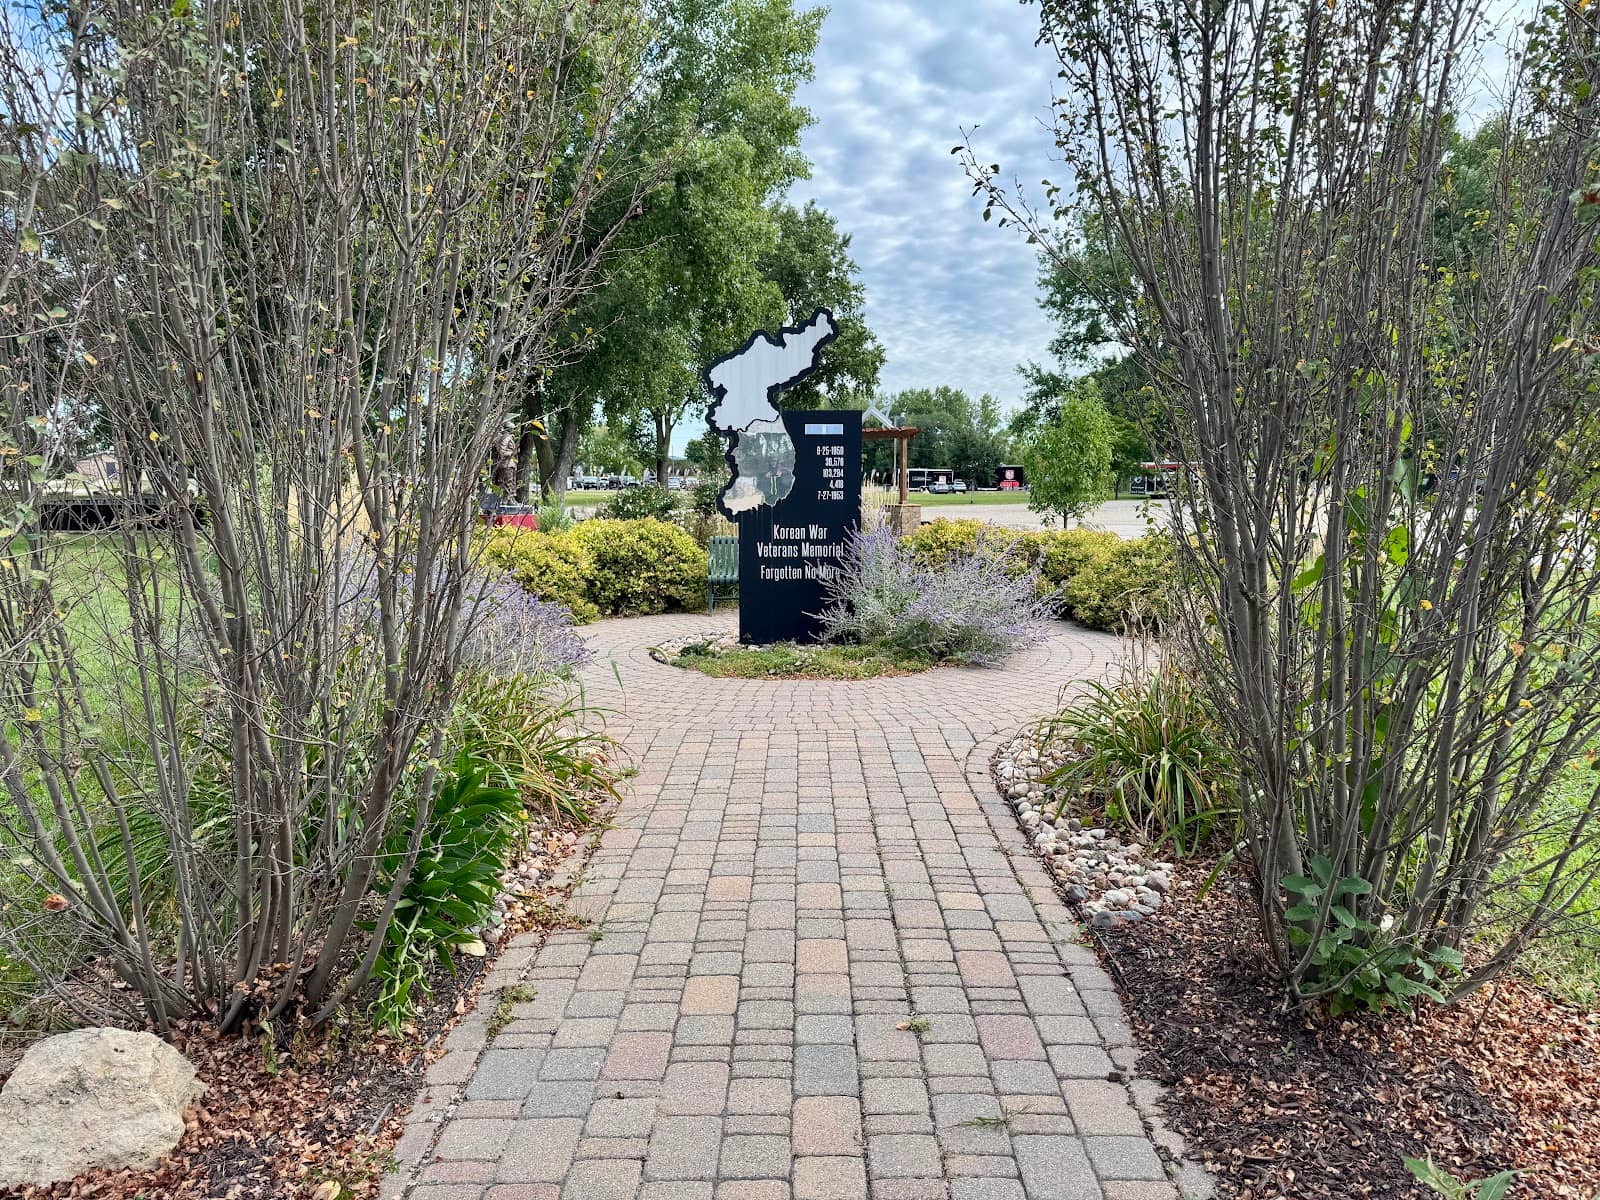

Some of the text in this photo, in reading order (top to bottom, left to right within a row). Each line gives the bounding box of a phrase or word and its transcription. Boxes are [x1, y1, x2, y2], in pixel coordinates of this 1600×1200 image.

[817, 491, 844, 500] 7-27-1953
[773, 524, 828, 540] Korean War
[757, 541, 844, 558] Veterans Memorial
[760, 565, 802, 582] Forgotten
[804, 565, 817, 580] No
